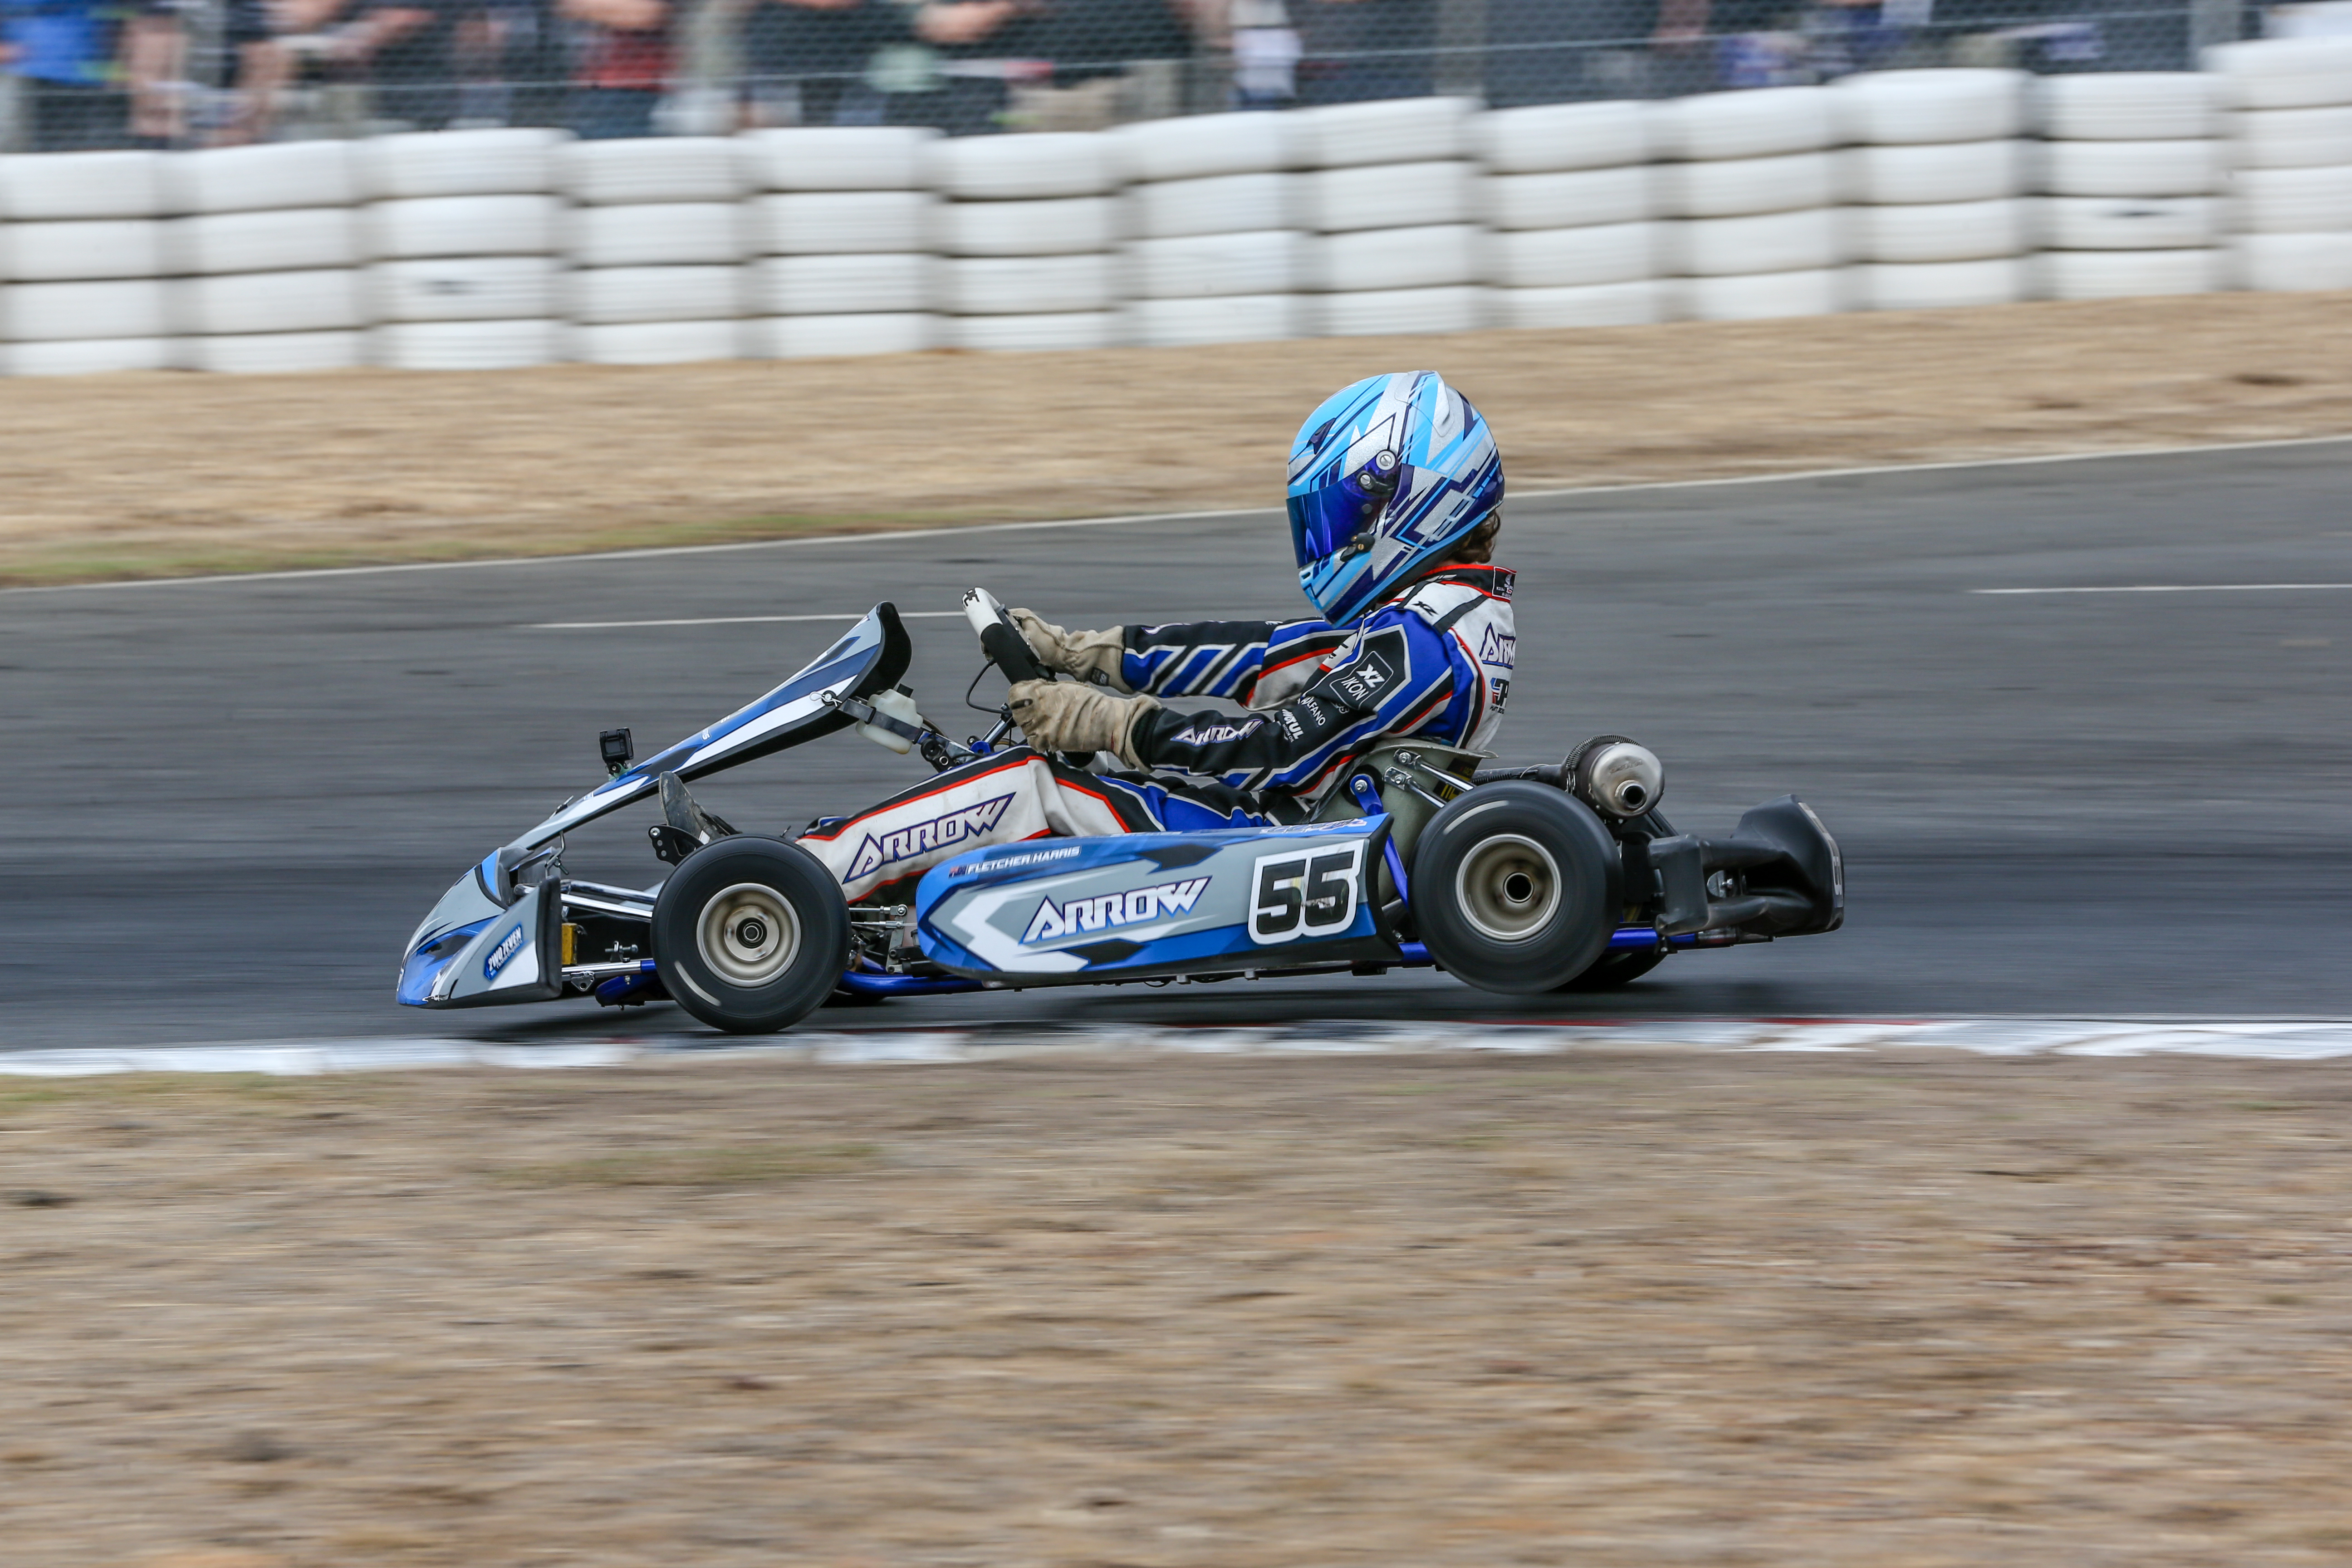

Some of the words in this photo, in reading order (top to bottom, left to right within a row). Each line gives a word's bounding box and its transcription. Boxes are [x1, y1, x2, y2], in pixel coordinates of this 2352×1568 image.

[1341, 676, 1369, 701] IKON
[1282, 709, 1304, 740] MOTUL
[1300, 696, 1326, 726] ALFANO
[1283, 724, 1291, 736] MOTOR
[842, 791, 1016, 884] ARROW
[966, 853, 1031, 875] FLETCHER
[1032, 845, 1082, 864] HARRIS
[1254, 847, 1357, 937] 55
[1019, 876, 1212, 946] ARROW
